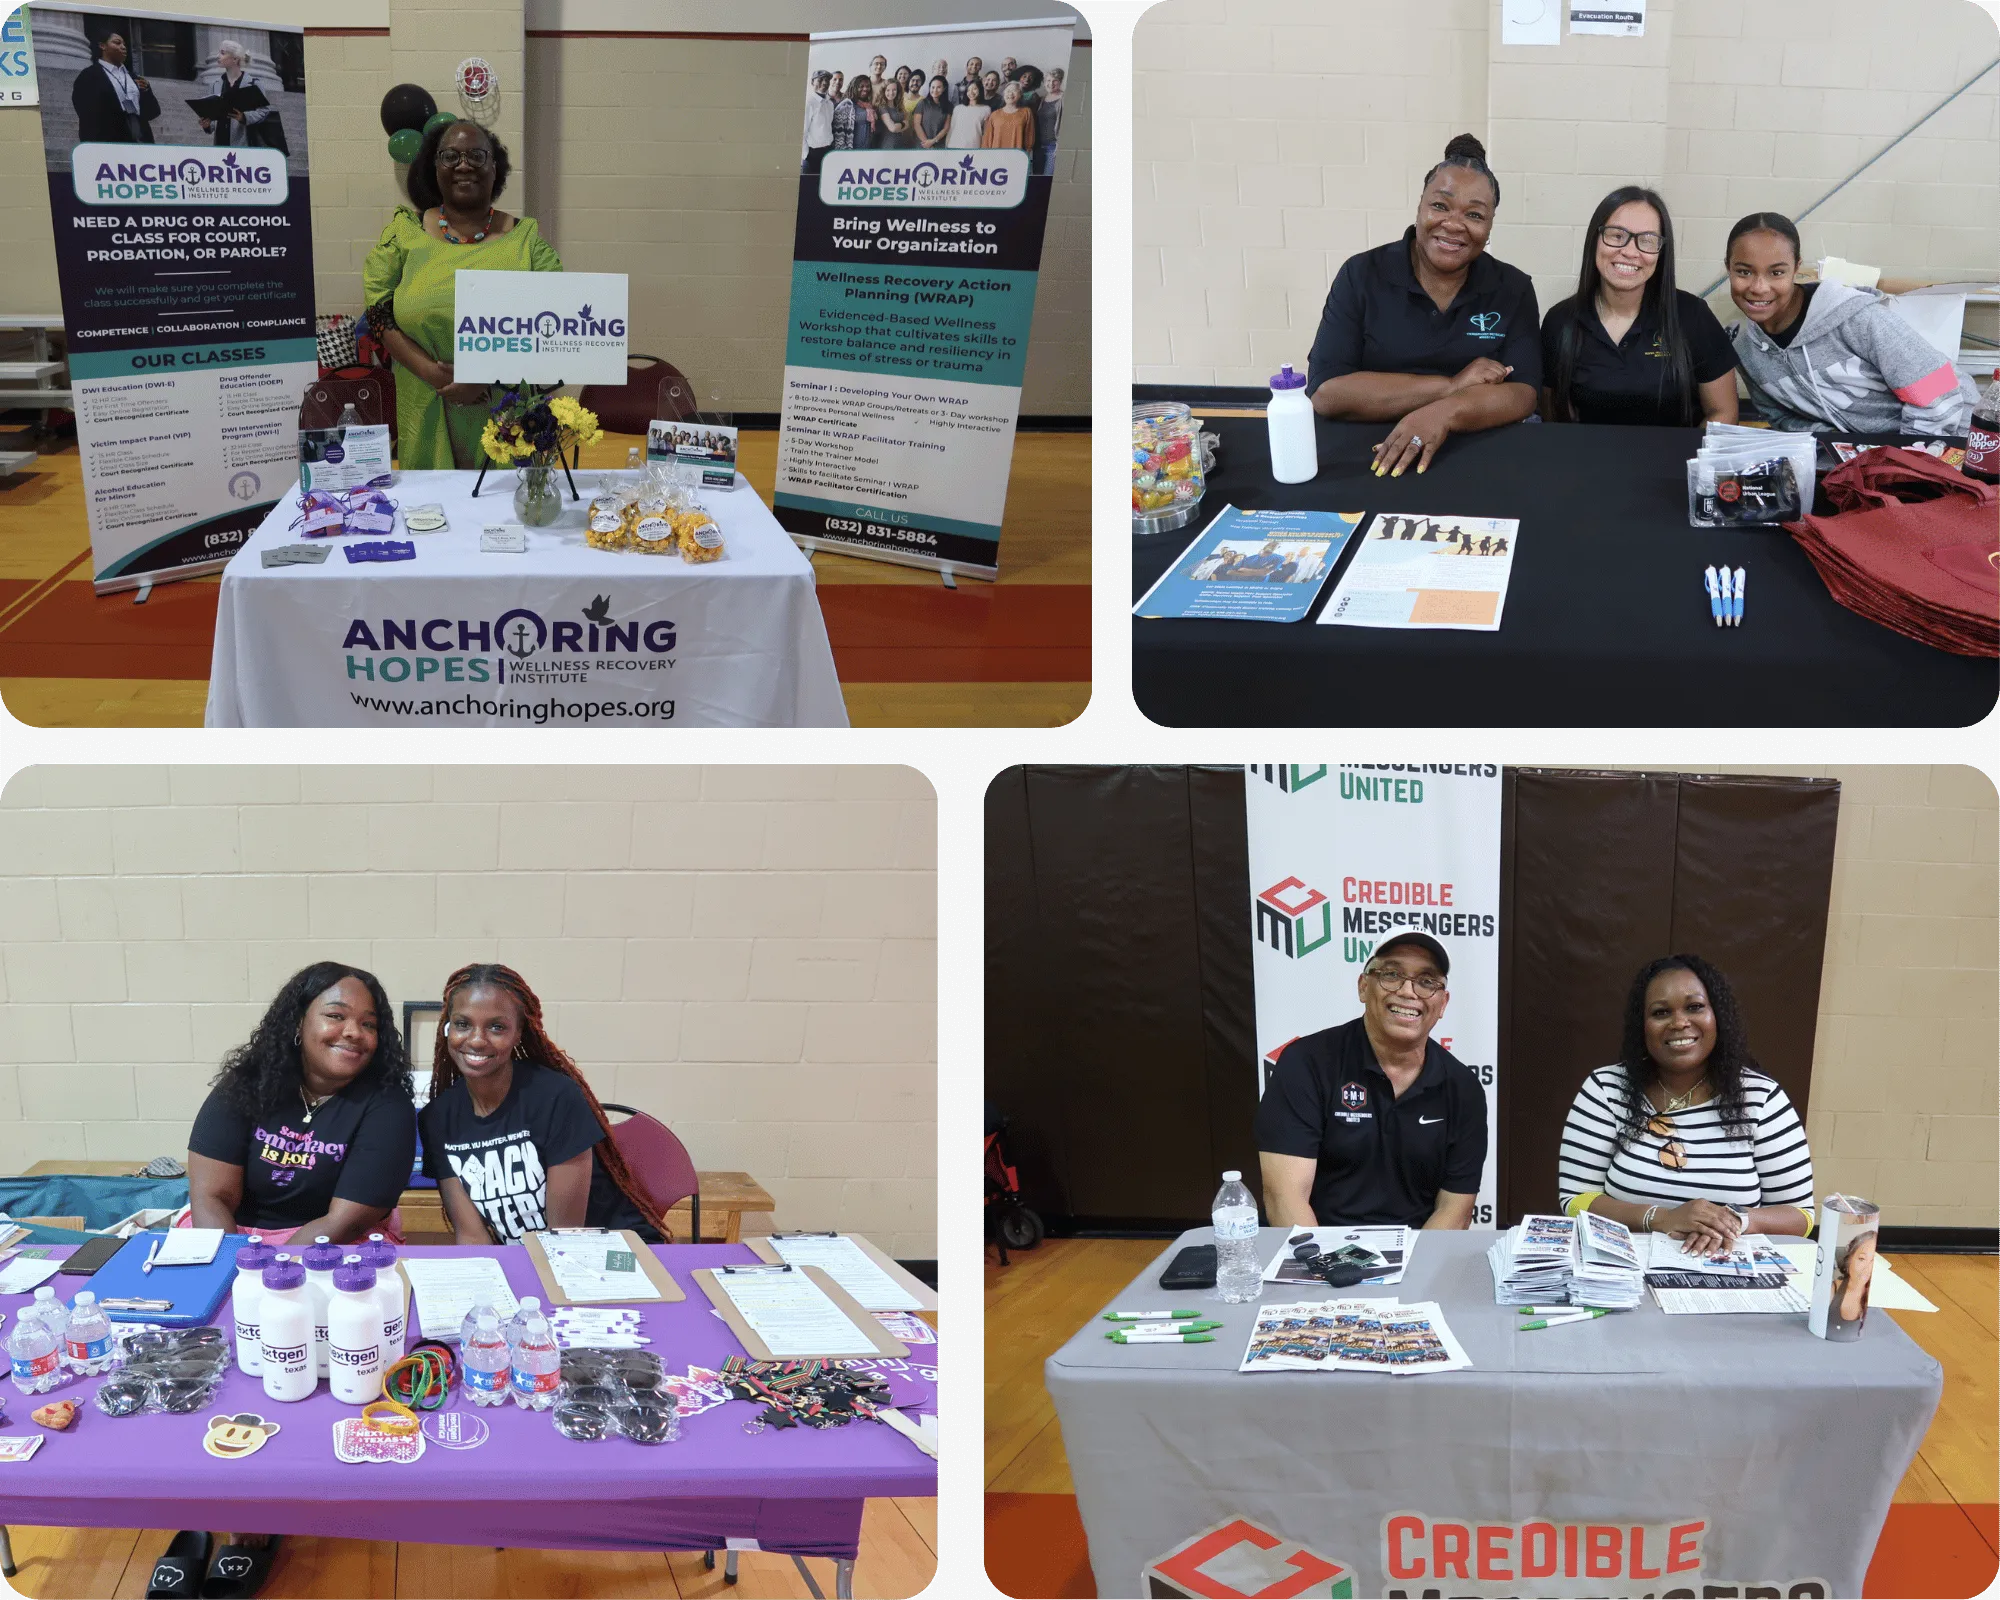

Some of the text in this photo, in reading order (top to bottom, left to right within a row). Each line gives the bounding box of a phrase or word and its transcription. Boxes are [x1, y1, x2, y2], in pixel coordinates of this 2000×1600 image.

[95, 157, 272, 186] ANCHORING
[837, 162, 1009, 187] ANCHORING
[98, 184, 178, 199] HOPES
[188, 186, 229, 194] WELLNESS
[837, 187, 909, 202] HOPES
[73, 215, 291, 228] NEED A DRUG OR ALCOHOL
[833, 217, 996, 234] Bring Wellness to
[111, 231, 260, 245] CLASS FOR COURT,
[832, 236, 998, 254] Your Organization
[87, 246, 287, 262] PROBATION, OR PAROLE?
[95, 280, 284, 296] We will make sure you complete the
[816, 271, 1011, 291] Wellness Recovery Action
[84, 290, 297, 309] class successfully and get your certificate
[845, 288, 974, 308] Planning (WRAP)
[76, 318, 307, 339] COMPETENCE COLLABORATION COMPLIANCE
[457, 311, 625, 338] ANCHORING
[819, 309, 997, 330] Evidenced-Based Wellness
[799, 320, 1016, 347] Workshop that cultivates skills to
[459, 336, 533, 353] HOPES
[800, 335, 1011, 361] restore balance and resiliency in
[131, 347, 266, 369] OUR CLASSES
[820, 349, 983, 373] times of stress or trauma
[102, 384, 143, 392] Education
[145, 381, 175, 389] (DWI-E)
[220, 379, 284, 390] Education (DOEP)
[790, 381, 969, 405] Seminar Developing Your Own WRAP
[794, 395, 840, 405] 8-to-12-week
[867, 402, 929, 415] Groups/Retreats
[951, 411, 967, 419] Day
[968, 415, 1009, 424] workshop
[794, 404, 895, 421] Improves Personal Wellness
[818, 417, 858, 428] Certificate
[929, 420, 1001, 433] Highly Interactive
[173, 432, 191, 440] (VIP)
[786, 425, 821, 435] Seminar
[833, 432, 860, 440] WRAP
[862, 435, 906, 446] Facilitator
[908, 441, 946, 452] Training
[1969, 432, 1999, 450] Pepper
[788, 466, 807, 475] Skills
[819, 470, 851, 481] facilitate
[853, 476, 886, 486] Seminar
[893, 482, 919, 490] WRAP
[788, 476, 908, 499] WRAP Facilitator Certification
[855, 508, 908, 524] CALL US
[204, 530, 243, 548] (832)
[825, 517, 938, 546] (832) 831-5884
[822, 532, 937, 558] www.anchoringhopes.org
[342, 608, 677, 655] ANCHORING
[346, 655, 490, 682] HOPES
[509, 659, 677, 672] WELLNESS RECOVERY
[510, 673, 588, 684] INSTITUTE
[350, 692, 676, 724] www.anchoringhopes.org
[1340, 772, 1423, 803] UNITED
[1343, 877, 1453, 906] CREDIBLE
[1343, 907, 1495, 937] MESSENGERS
[261, 1144, 279, 1161] is
[284, 1364, 307, 1373] texas
[357, 1365, 379, 1376] texas
[438, 1414, 446, 1439] america
[450, 1414, 459, 1441] nextgen
[1387, 1515, 1705, 1581] CREDIBLE
